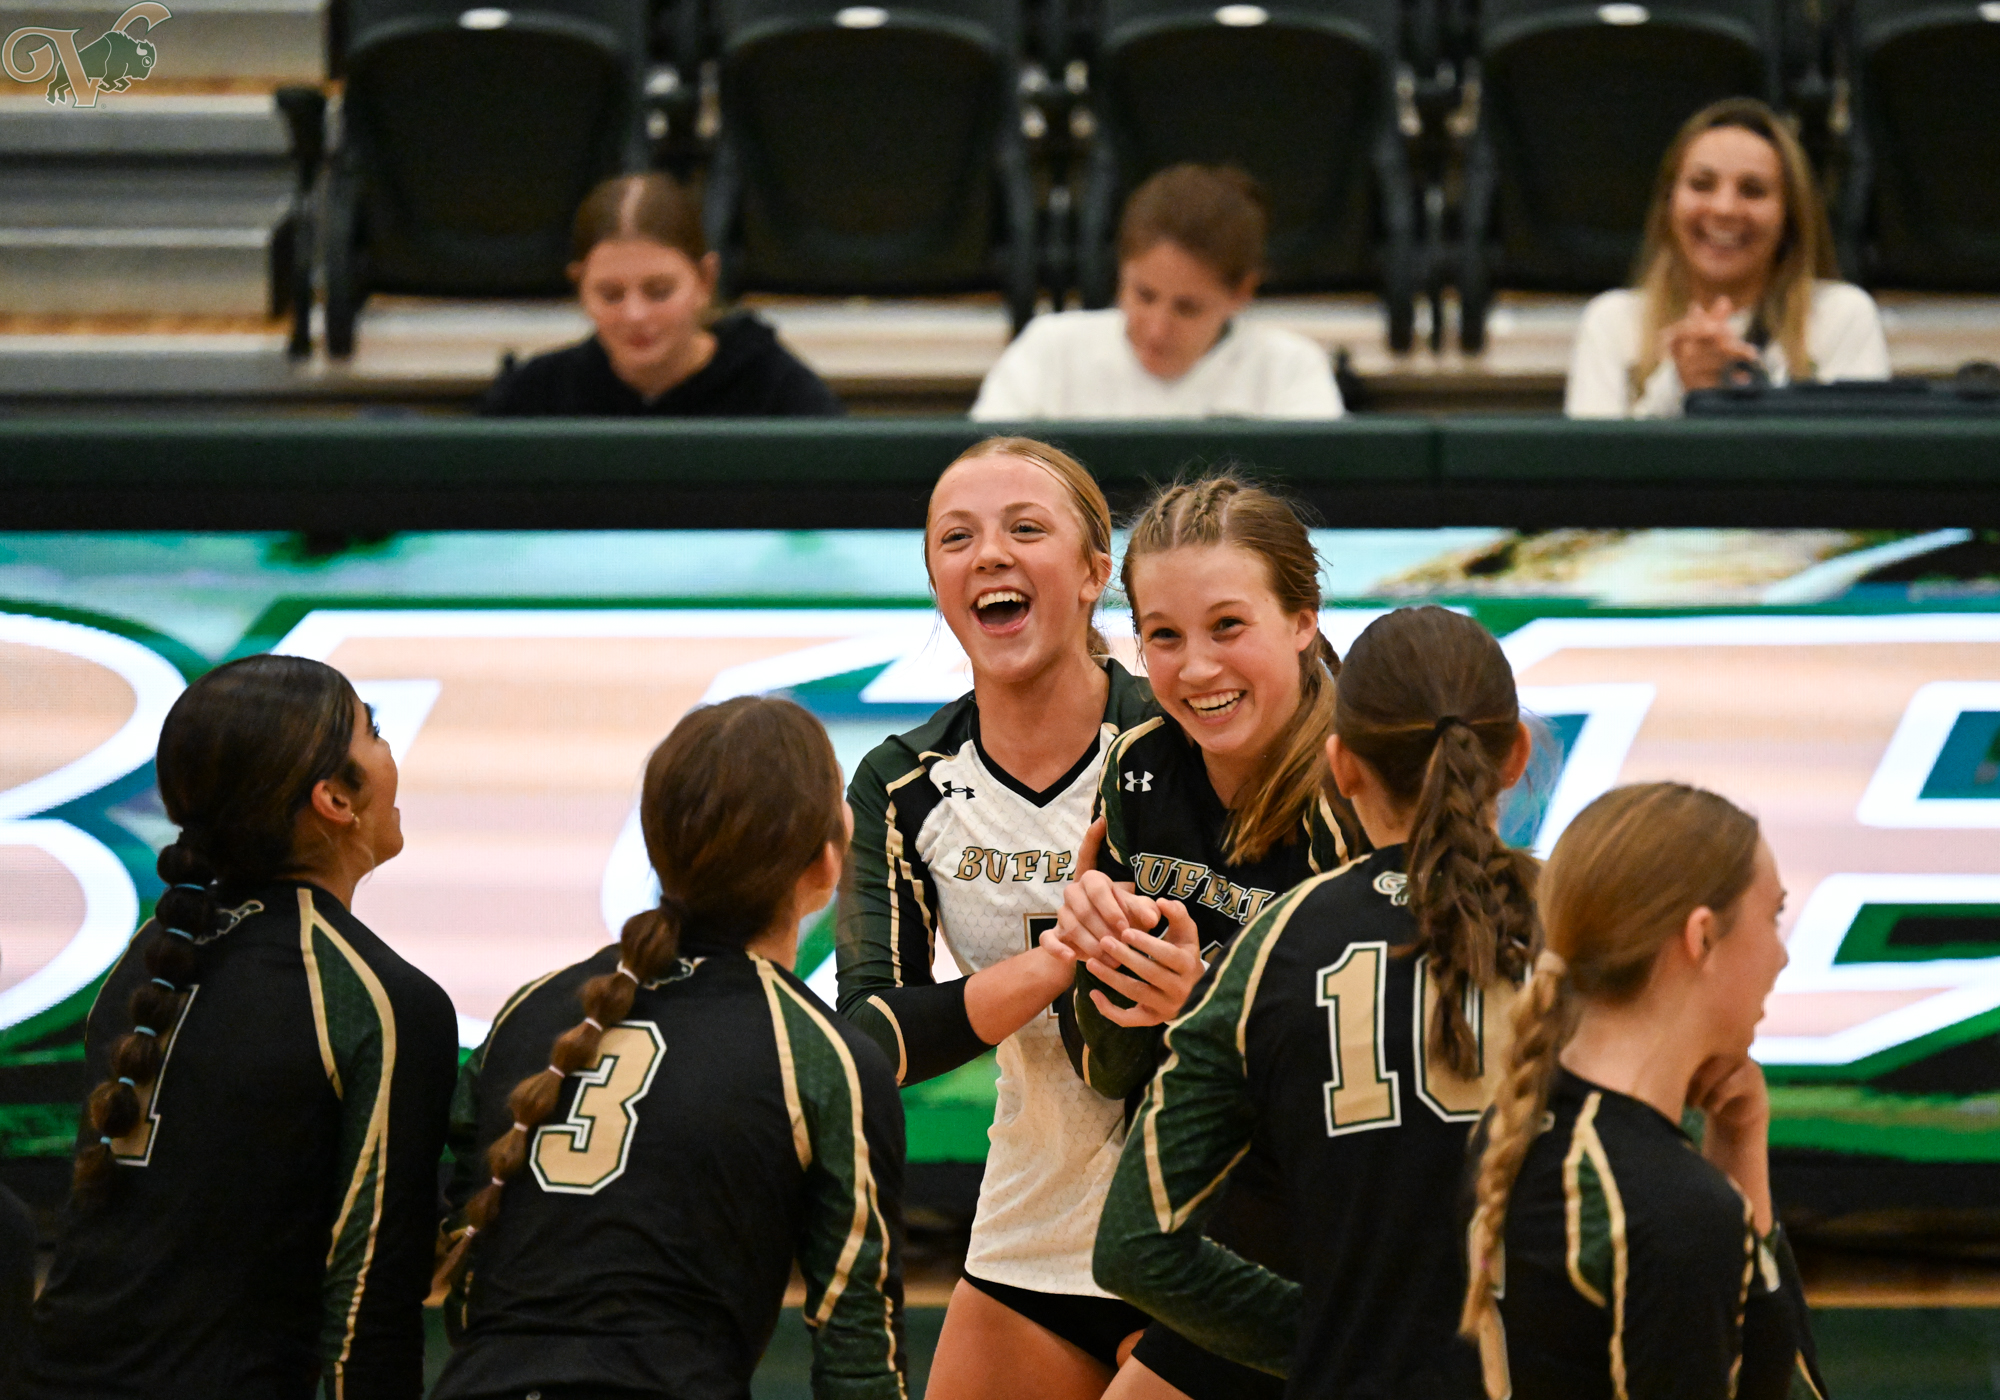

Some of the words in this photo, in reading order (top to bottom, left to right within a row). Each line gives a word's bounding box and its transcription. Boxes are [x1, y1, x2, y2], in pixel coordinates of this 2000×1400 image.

[953, 846, 1077, 884] BUFF
[1130, 852, 1276, 925] UFFAL
[1316, 940, 1533, 1138] 10
[530, 1020, 667, 1195] 3
